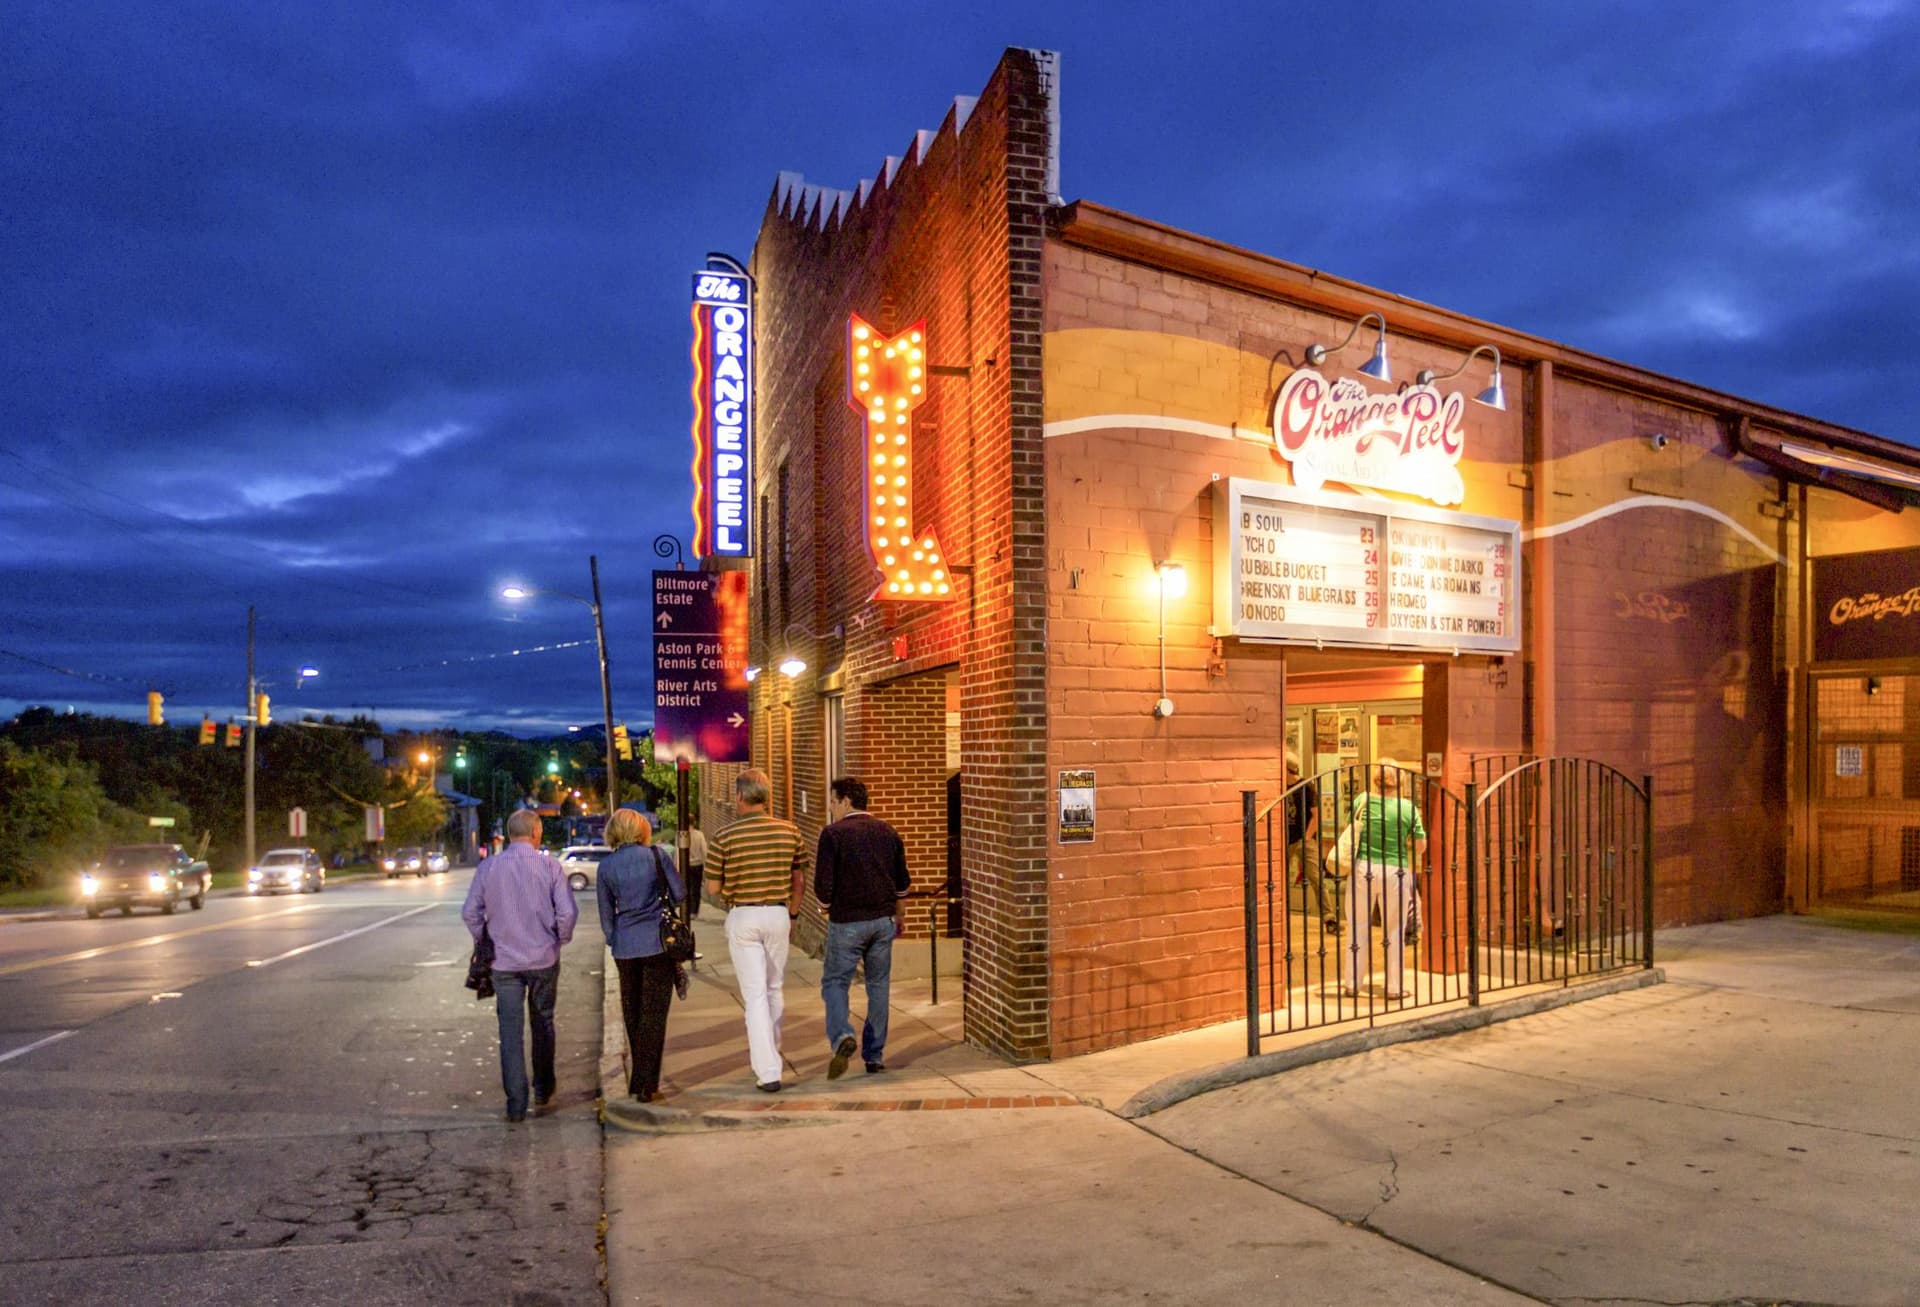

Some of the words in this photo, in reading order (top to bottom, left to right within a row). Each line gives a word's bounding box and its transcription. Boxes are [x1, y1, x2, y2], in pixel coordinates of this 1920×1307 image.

[696, 276, 740, 300] The
[714, 307, 744, 451] ORANGE
[1332, 381, 1364, 401] The
[1281, 377, 1402, 454] Orange
[1402, 391, 1459, 455] Peel
[716, 454, 743, 551] PEEL
[1256, 514, 1285, 533] SOUL
[1360, 527, 1374, 544] 23
[1240, 535, 1275, 555] YCHO
[1364, 550, 1378, 565] 24
[1454, 559, 1484, 576] DARKO
[1494, 563, 1505, 578] 29
[656, 578, 709, 590] Biltmore
[1364, 571, 1378, 586] 25
[1401, 573, 1425, 589] CAME
[656, 593, 693, 605] Estate
[1298, 586, 1357, 606] BLUEGRASS
[1365, 592, 1378, 607] 26
[1498, 602, 1504, 616] 2
[1829, 597, 1905, 625] Orange
[1390, 613, 1428, 630] OXYGEN
[1430, 616, 1438, 630] &
[1440, 617, 1463, 633] STAR
[1467, 618, 1496, 634] POWER
[1496, 621, 1502, 635] 3
[657, 643, 692, 655] Aston
[696, 643, 723, 655] Park
[657, 657, 697, 669] Tennis
[701, 657, 741, 669] Center
[657, 680, 689, 692] River
[693, 680, 718, 692] Arts
[657, 694, 701, 706] District
